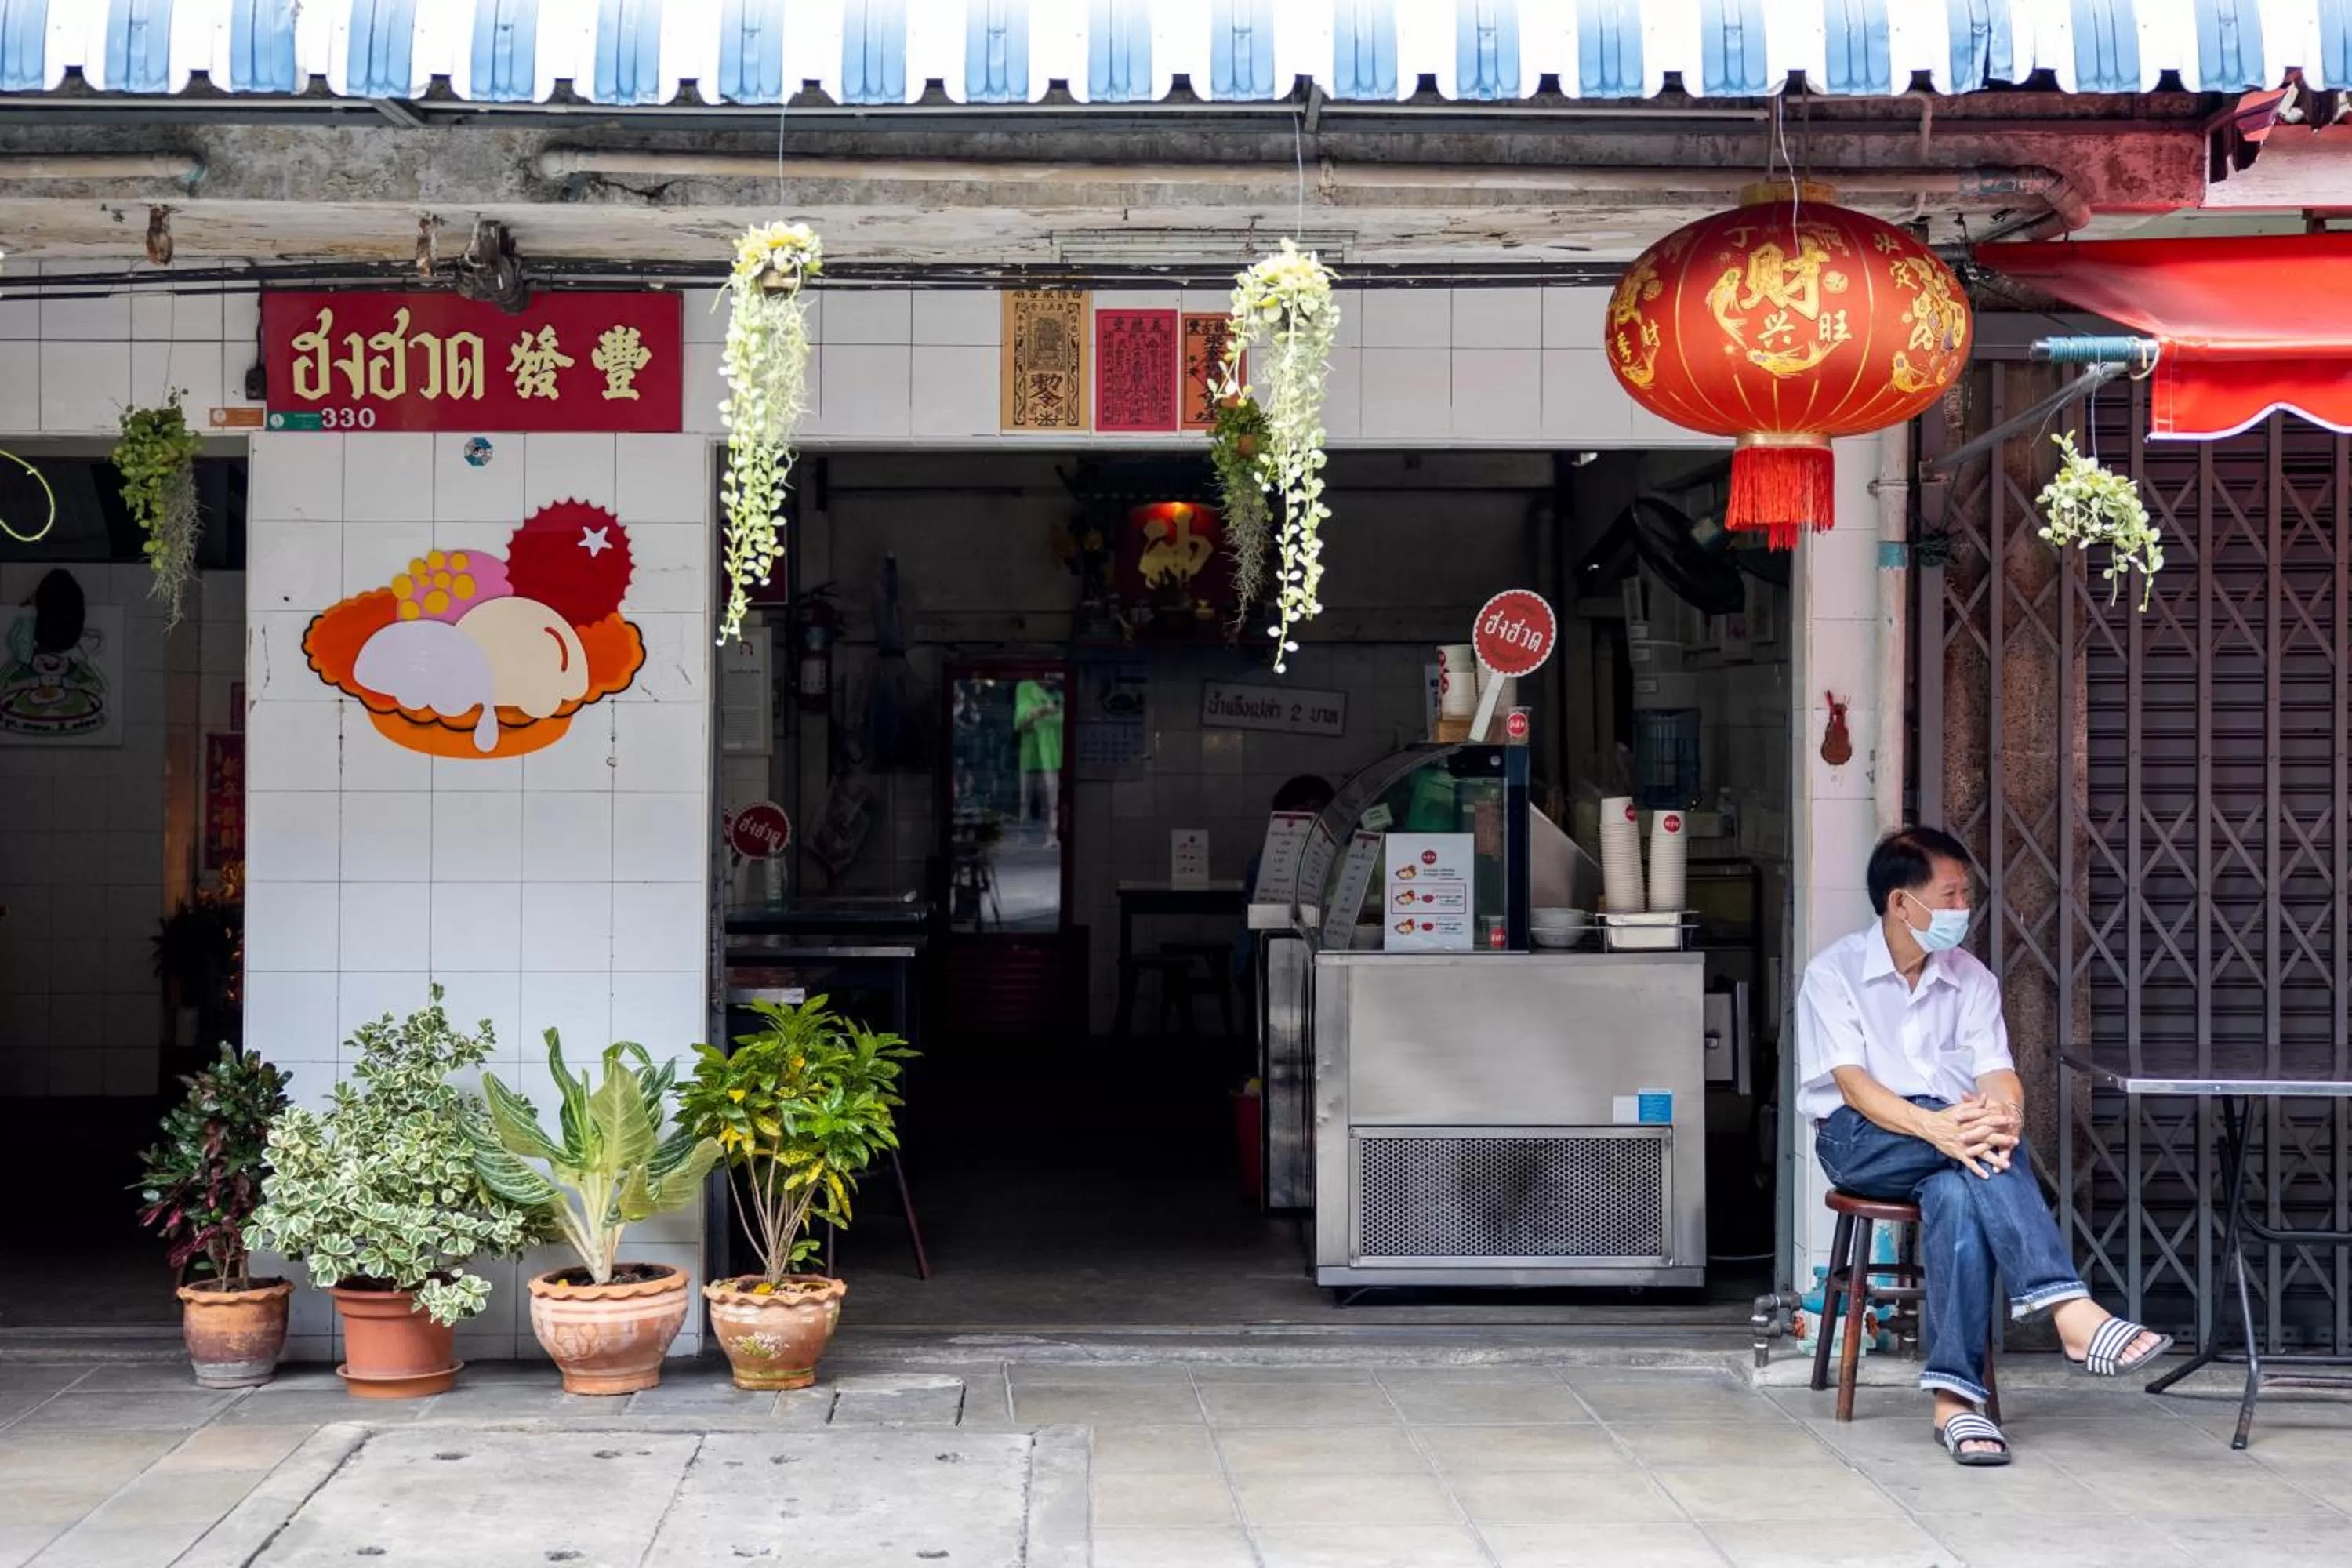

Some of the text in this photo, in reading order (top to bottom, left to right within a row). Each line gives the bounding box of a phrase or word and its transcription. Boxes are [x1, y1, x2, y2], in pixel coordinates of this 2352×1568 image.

[291, 307, 485, 401] ฮงฮวด
[320, 407, 376, 429] 330
[1483, 609, 1544, 652] ฮงฮวด
[1290, 702, 1303, 722] 2
